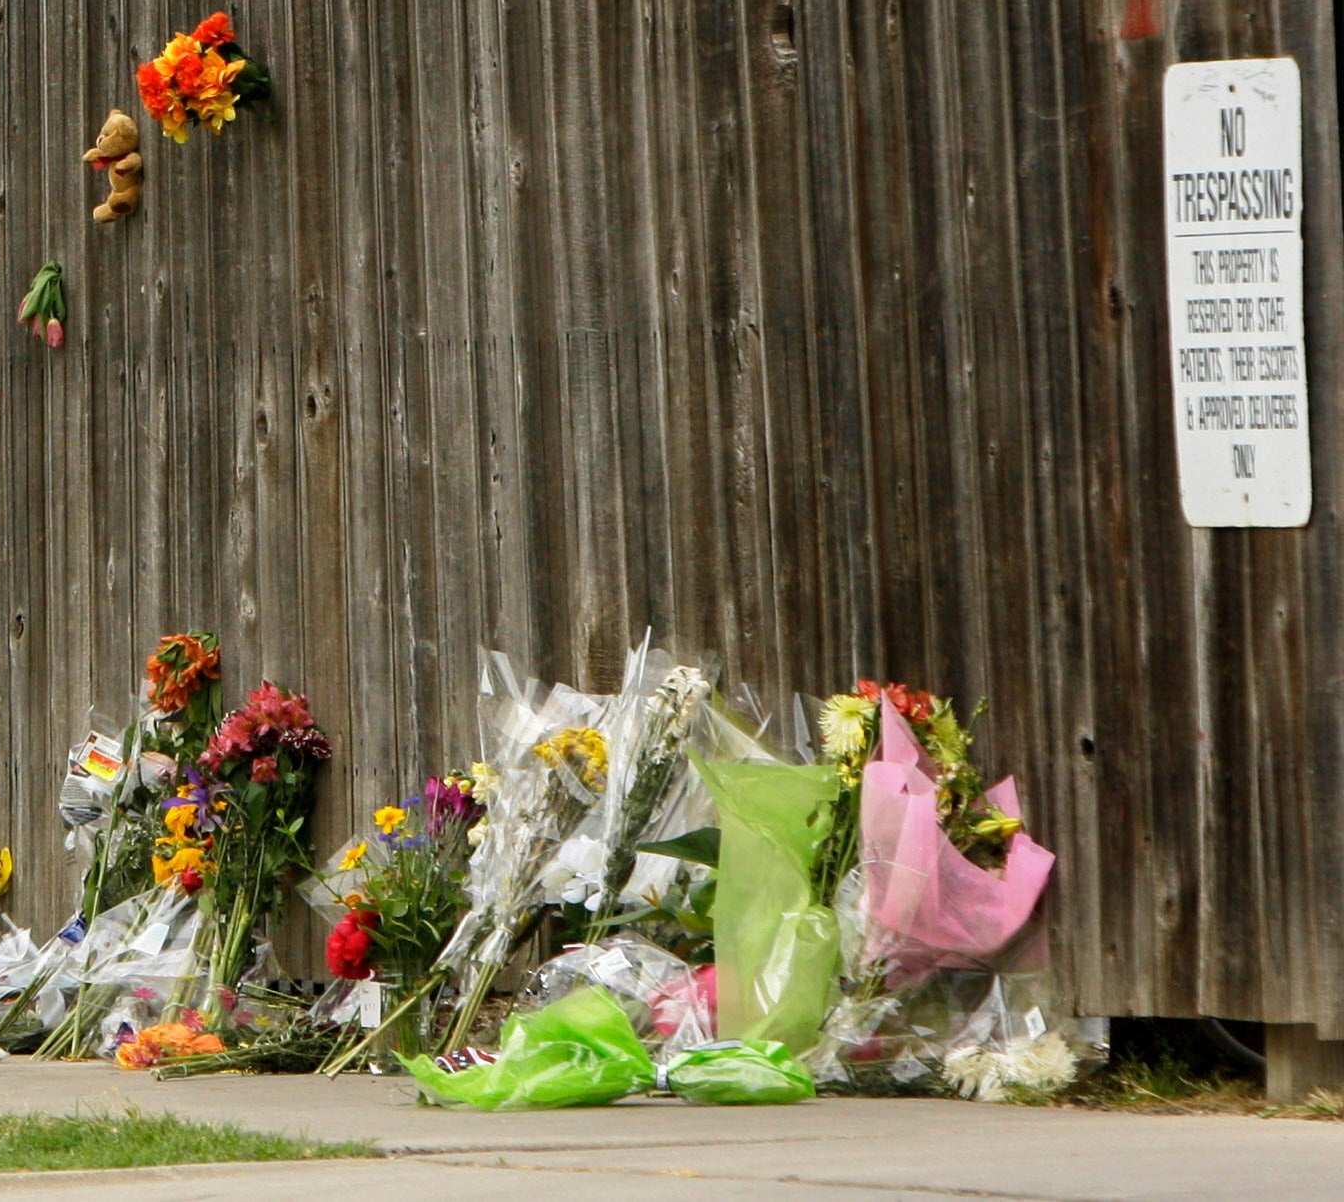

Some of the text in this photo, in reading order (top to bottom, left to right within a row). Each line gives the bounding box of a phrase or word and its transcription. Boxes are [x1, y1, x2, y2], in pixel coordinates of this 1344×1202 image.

[1220, 106, 1246, 158] NO
[1172, 168, 1294, 223] TRESPASSING
[1193, 247, 1280, 285] THIS PROPERTY IS
[1187, 298, 1233, 334] RESERVED
[1236, 297, 1255, 333] FOR
[1228, 346, 1256, 382] THEIR
[1258, 345, 1299, 381] ESCORTS
[1187, 394, 1299, 431] & APPROVED DELIVERIES
[1233, 444, 1256, 478] ONLY
